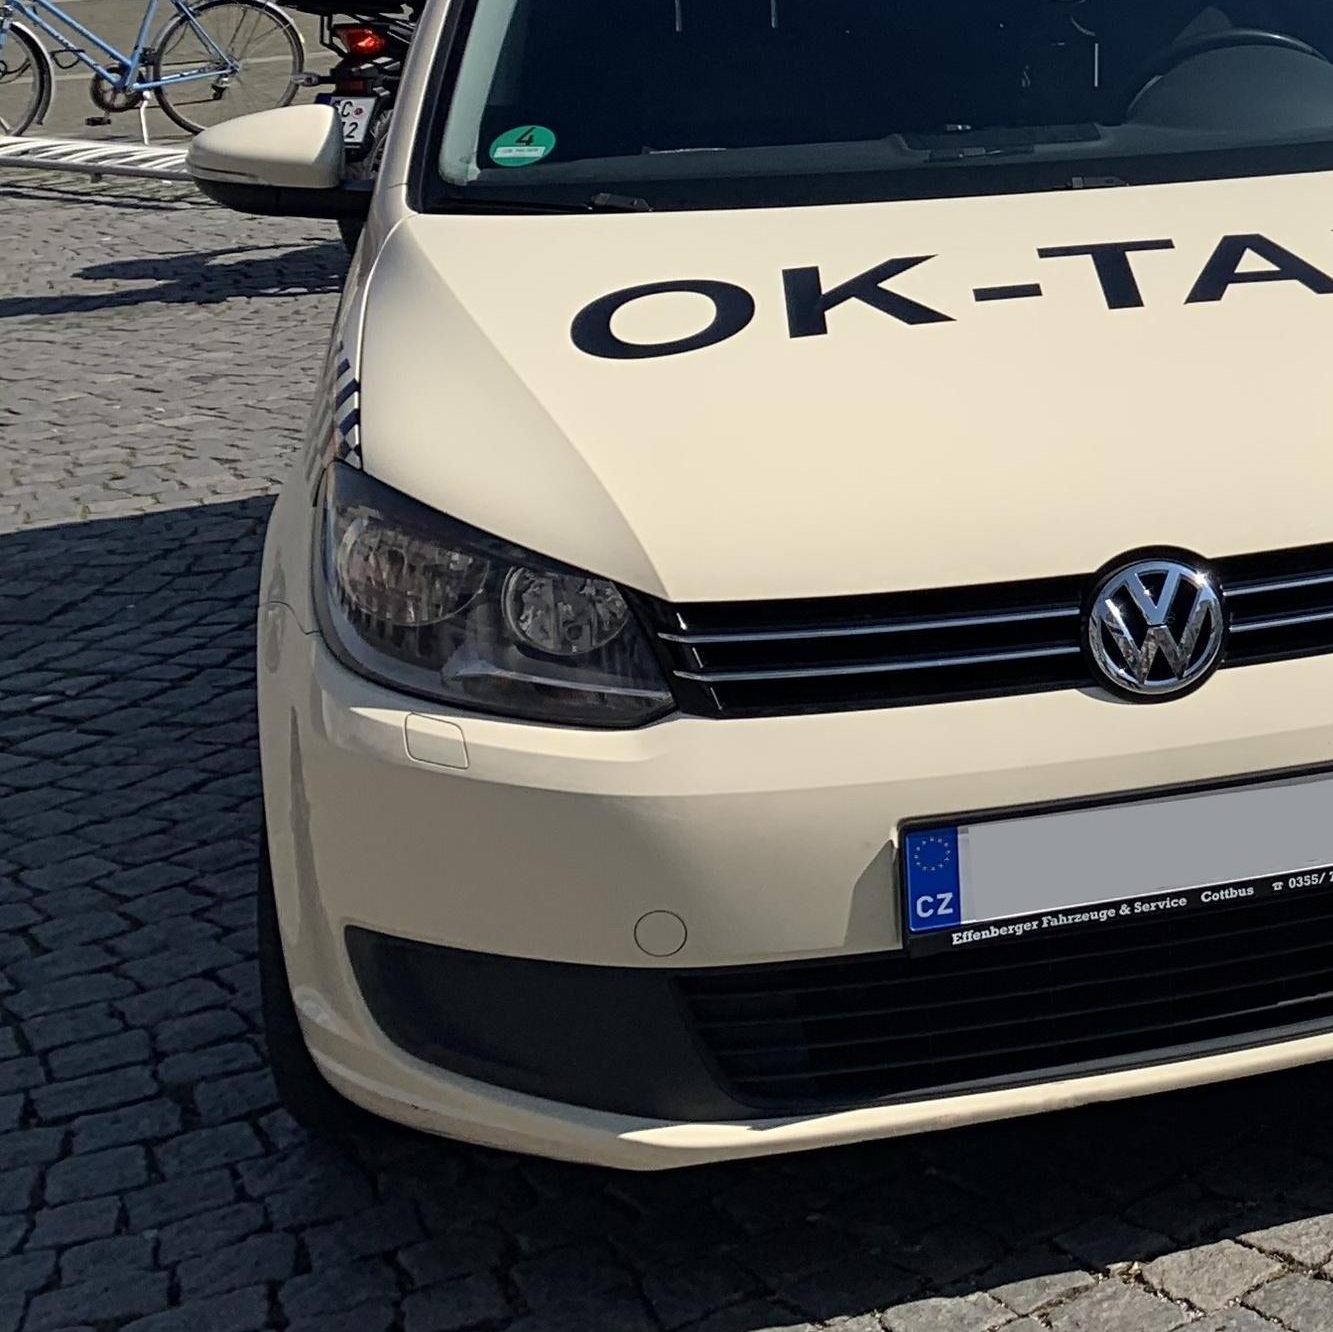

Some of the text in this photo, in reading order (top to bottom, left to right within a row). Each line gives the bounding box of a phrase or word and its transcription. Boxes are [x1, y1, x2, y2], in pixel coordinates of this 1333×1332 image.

[515, 126, 537, 146] 4
[915, 891, 954, 918] CZ
[951, 919, 1040, 946] Effenberger
[1041, 907, 1117, 929] Fahrzeuge
[1118, 903, 1131, 917] &
[1132, 895, 1189, 915] Service
[1199, 883, 1255, 904] Cottbus
[1287, 871, 1327, 890] 0355/
